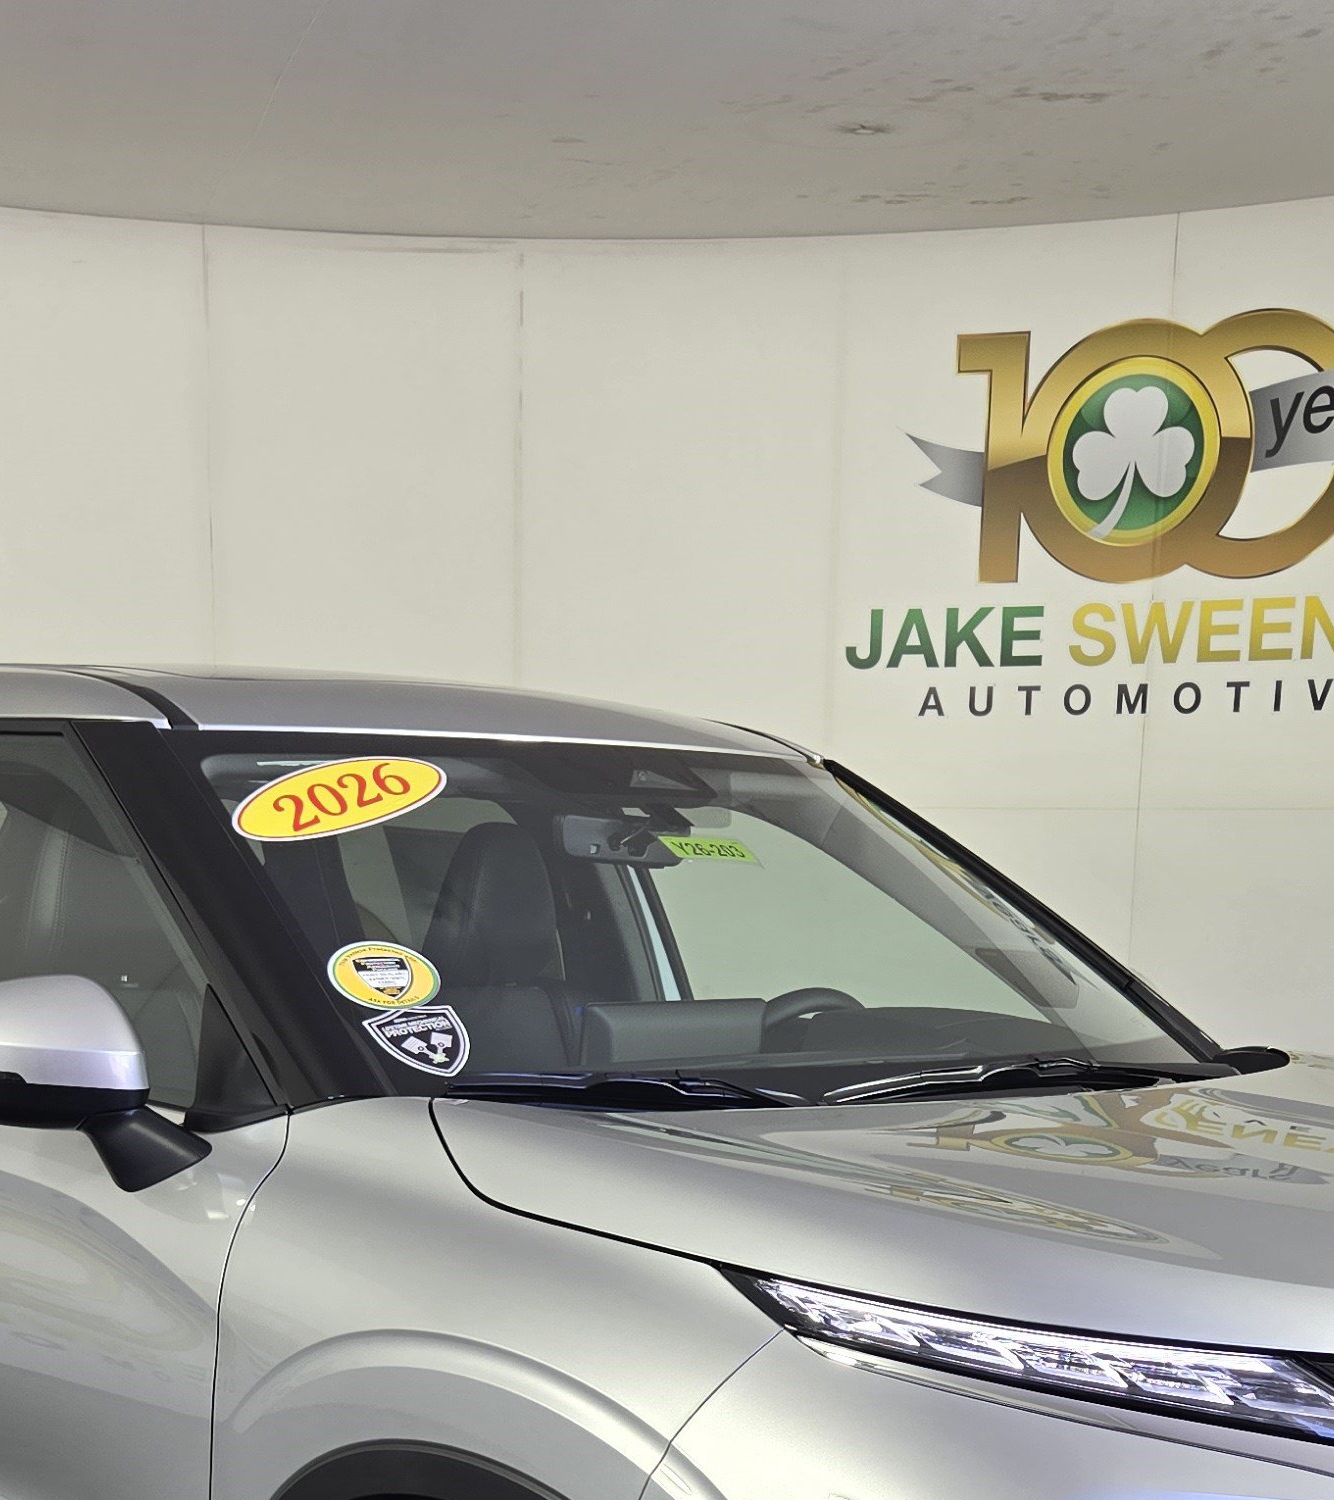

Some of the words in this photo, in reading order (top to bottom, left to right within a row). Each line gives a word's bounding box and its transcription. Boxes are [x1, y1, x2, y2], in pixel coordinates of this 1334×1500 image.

[845, 605, 1045, 670] JAKE
[272, 762, 411, 832] 2026
[384, 1019, 452, 1038] PROTECTION
